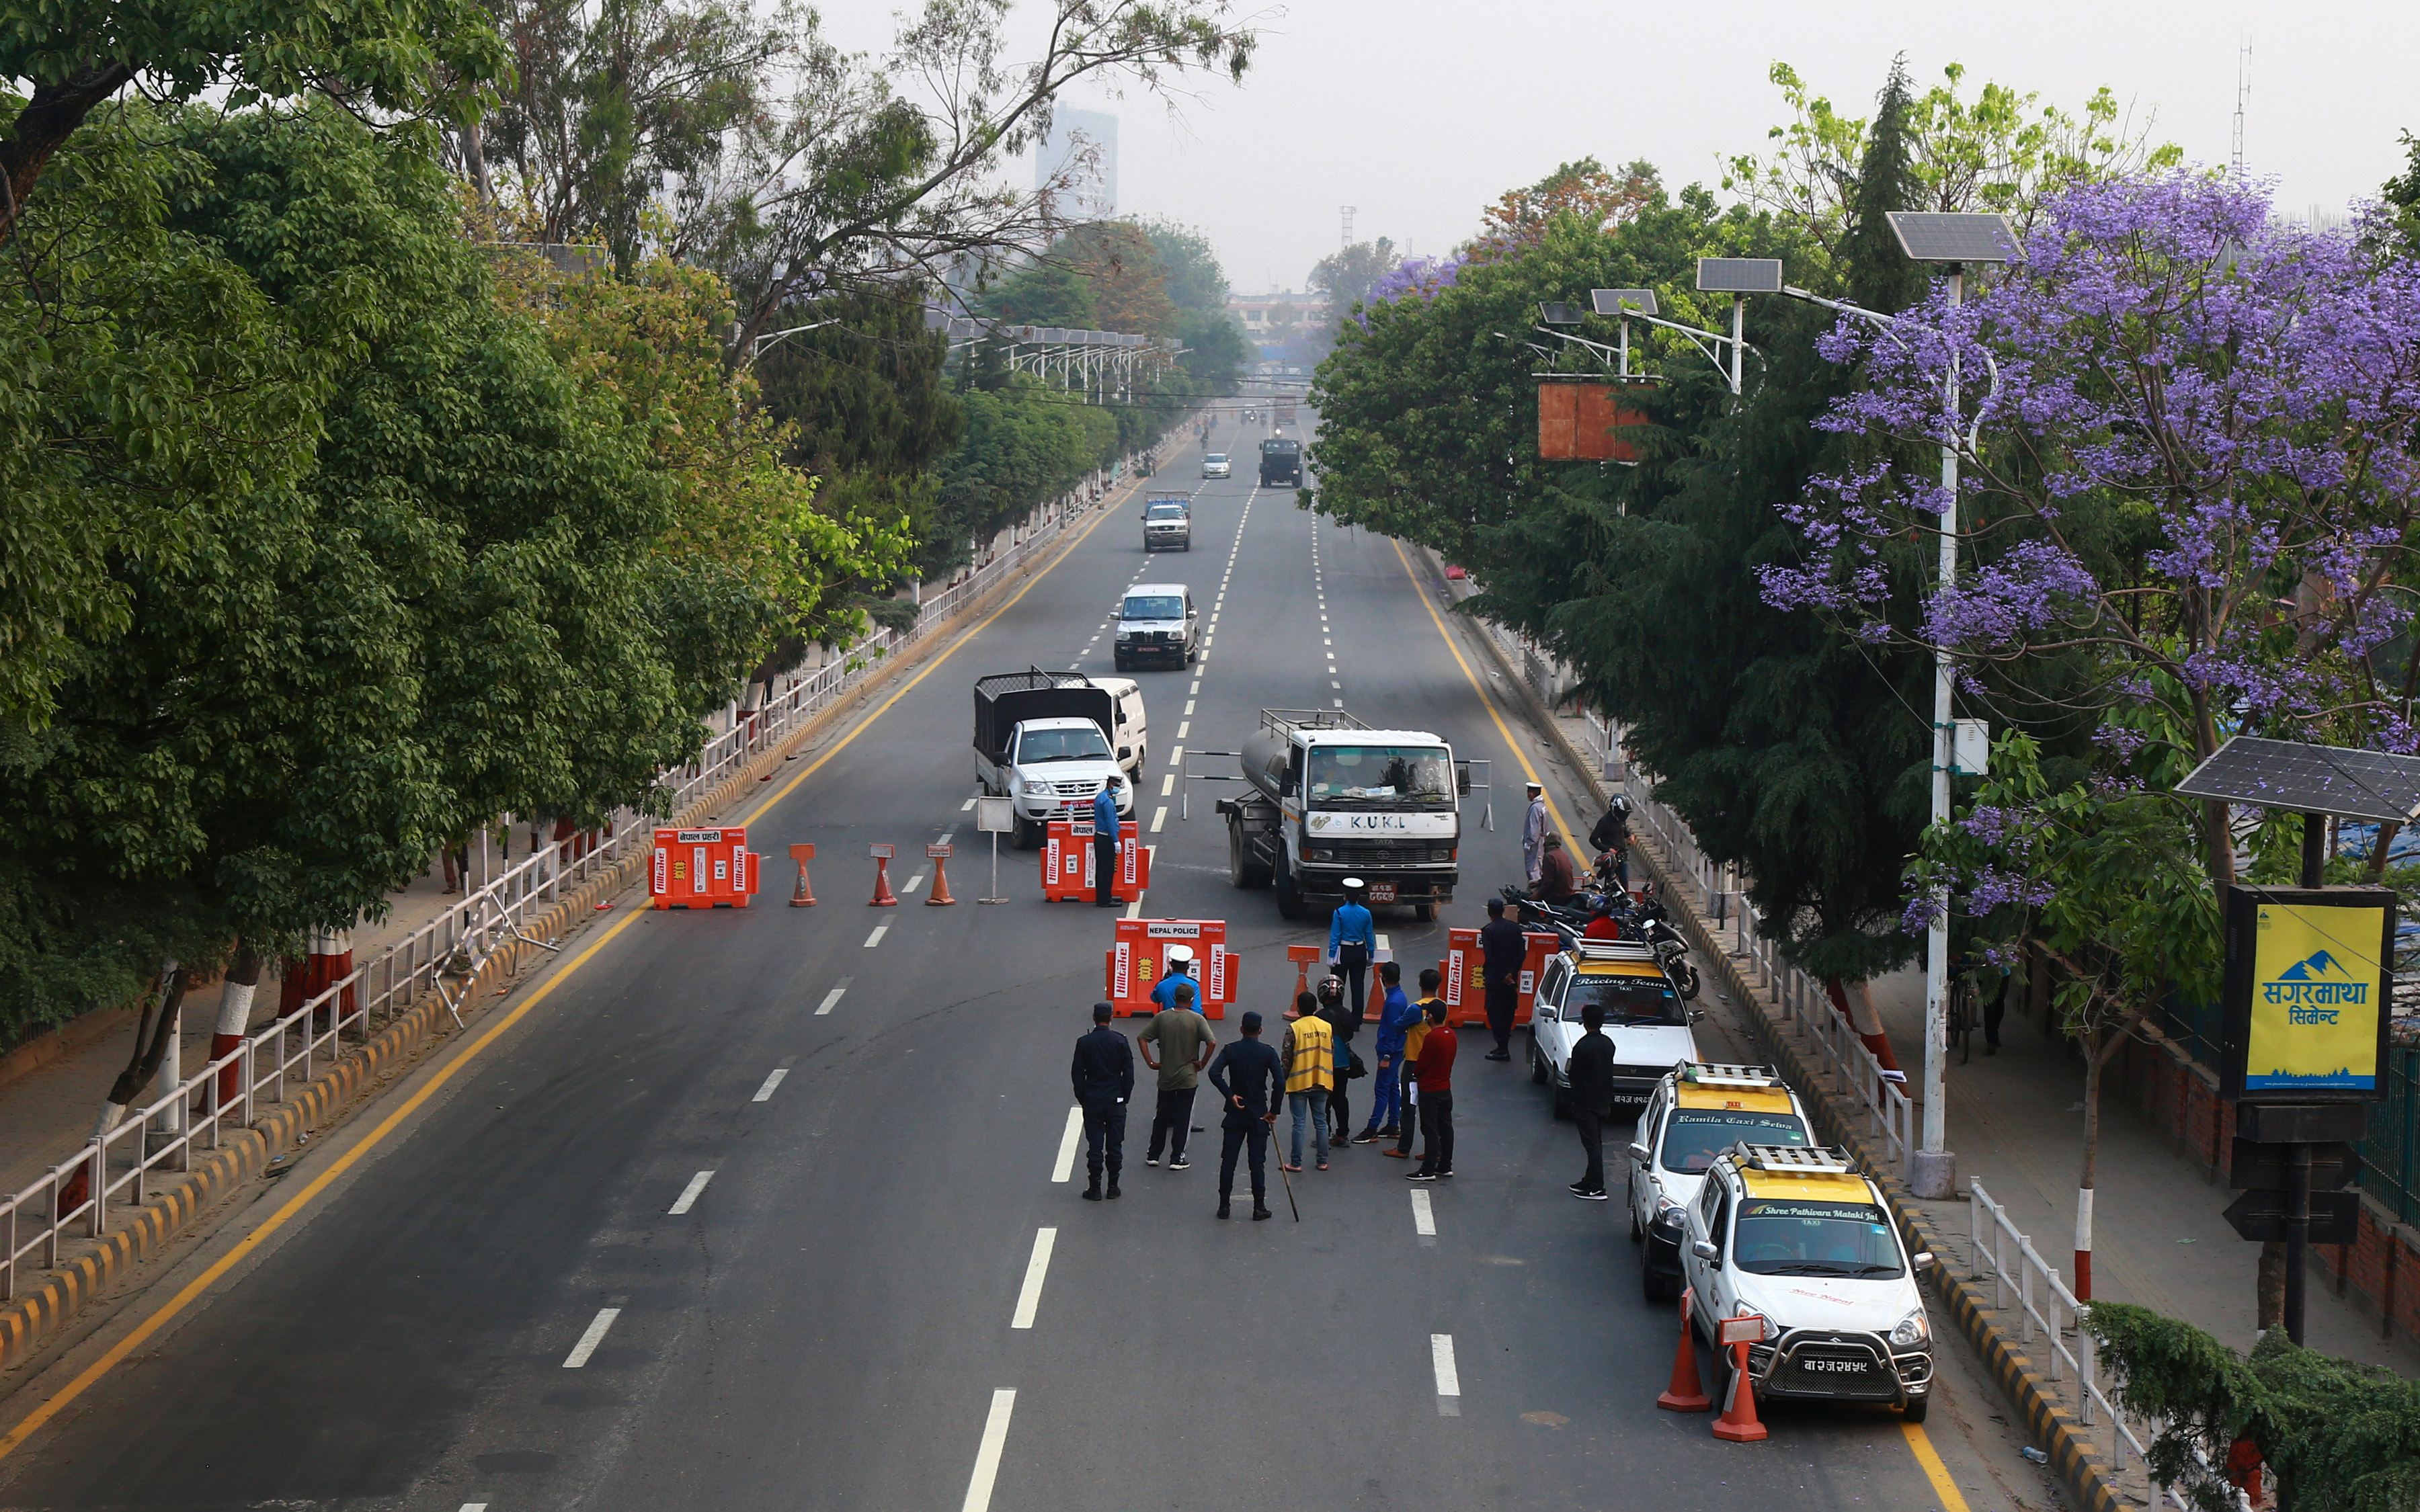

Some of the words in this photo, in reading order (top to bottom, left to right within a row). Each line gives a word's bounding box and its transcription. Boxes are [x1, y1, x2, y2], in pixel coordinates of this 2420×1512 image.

[680, 833, 700, 841] नेपाल
[702, 832, 719, 841] प्रहरी
[1073, 825, 1093, 835] नेपाल
[656, 852, 665, 890] Hilltake
[735, 850, 743, 888] Hilltake
[1049, 843, 1057, 881] Hilltake
[1126, 843, 1135, 880] Hilltake
[1117, 948, 1127, 994] Hilltake
[1213, 950, 1223, 995] Hilltake
[1449, 956, 1461, 1001] Hilltake
[1576, 977, 1627, 986] Racing
[1631, 978, 1668, 989] Team
[2262, 982, 2369, 1004] सगरमाथा
[2288, 1005, 2340, 1025] सिमेन्ट
[1765, 1207, 1789, 1215] Shree
[1789, 1208, 1832, 1217] Pathivara
[1865, 1212, 1879, 1221] Jai
